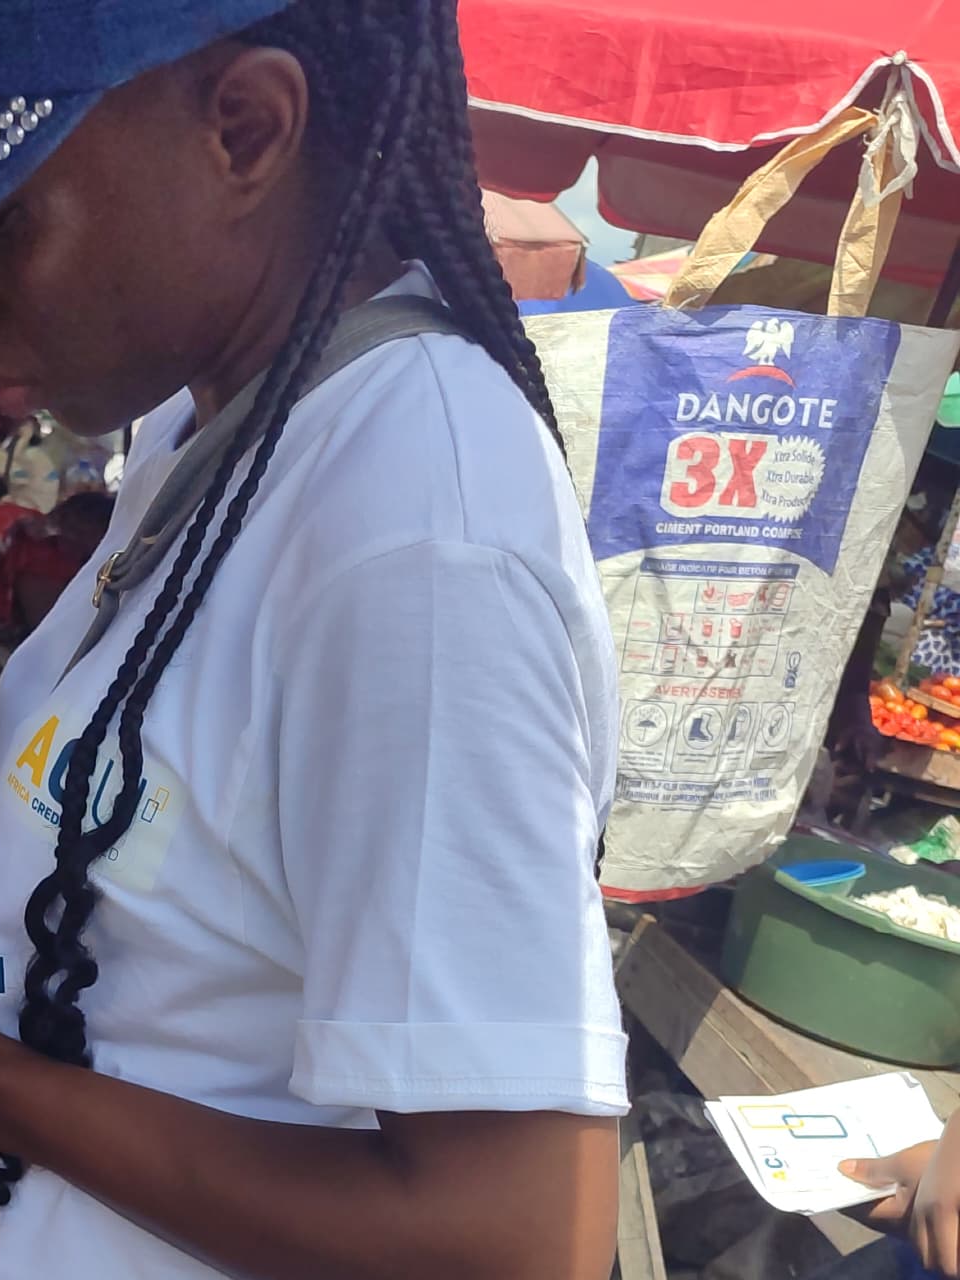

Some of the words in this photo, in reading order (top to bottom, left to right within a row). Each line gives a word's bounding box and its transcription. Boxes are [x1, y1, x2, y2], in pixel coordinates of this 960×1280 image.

[676, 393, 838, 428] DANGOTE
[669, 436, 768, 508] 3X
[656, 523, 702, 534] CIMENT
[704, 524, 759, 538] PORTLAND
[8, 773, 30, 804] AFRICA
[31, 797, 61, 826] CRED
